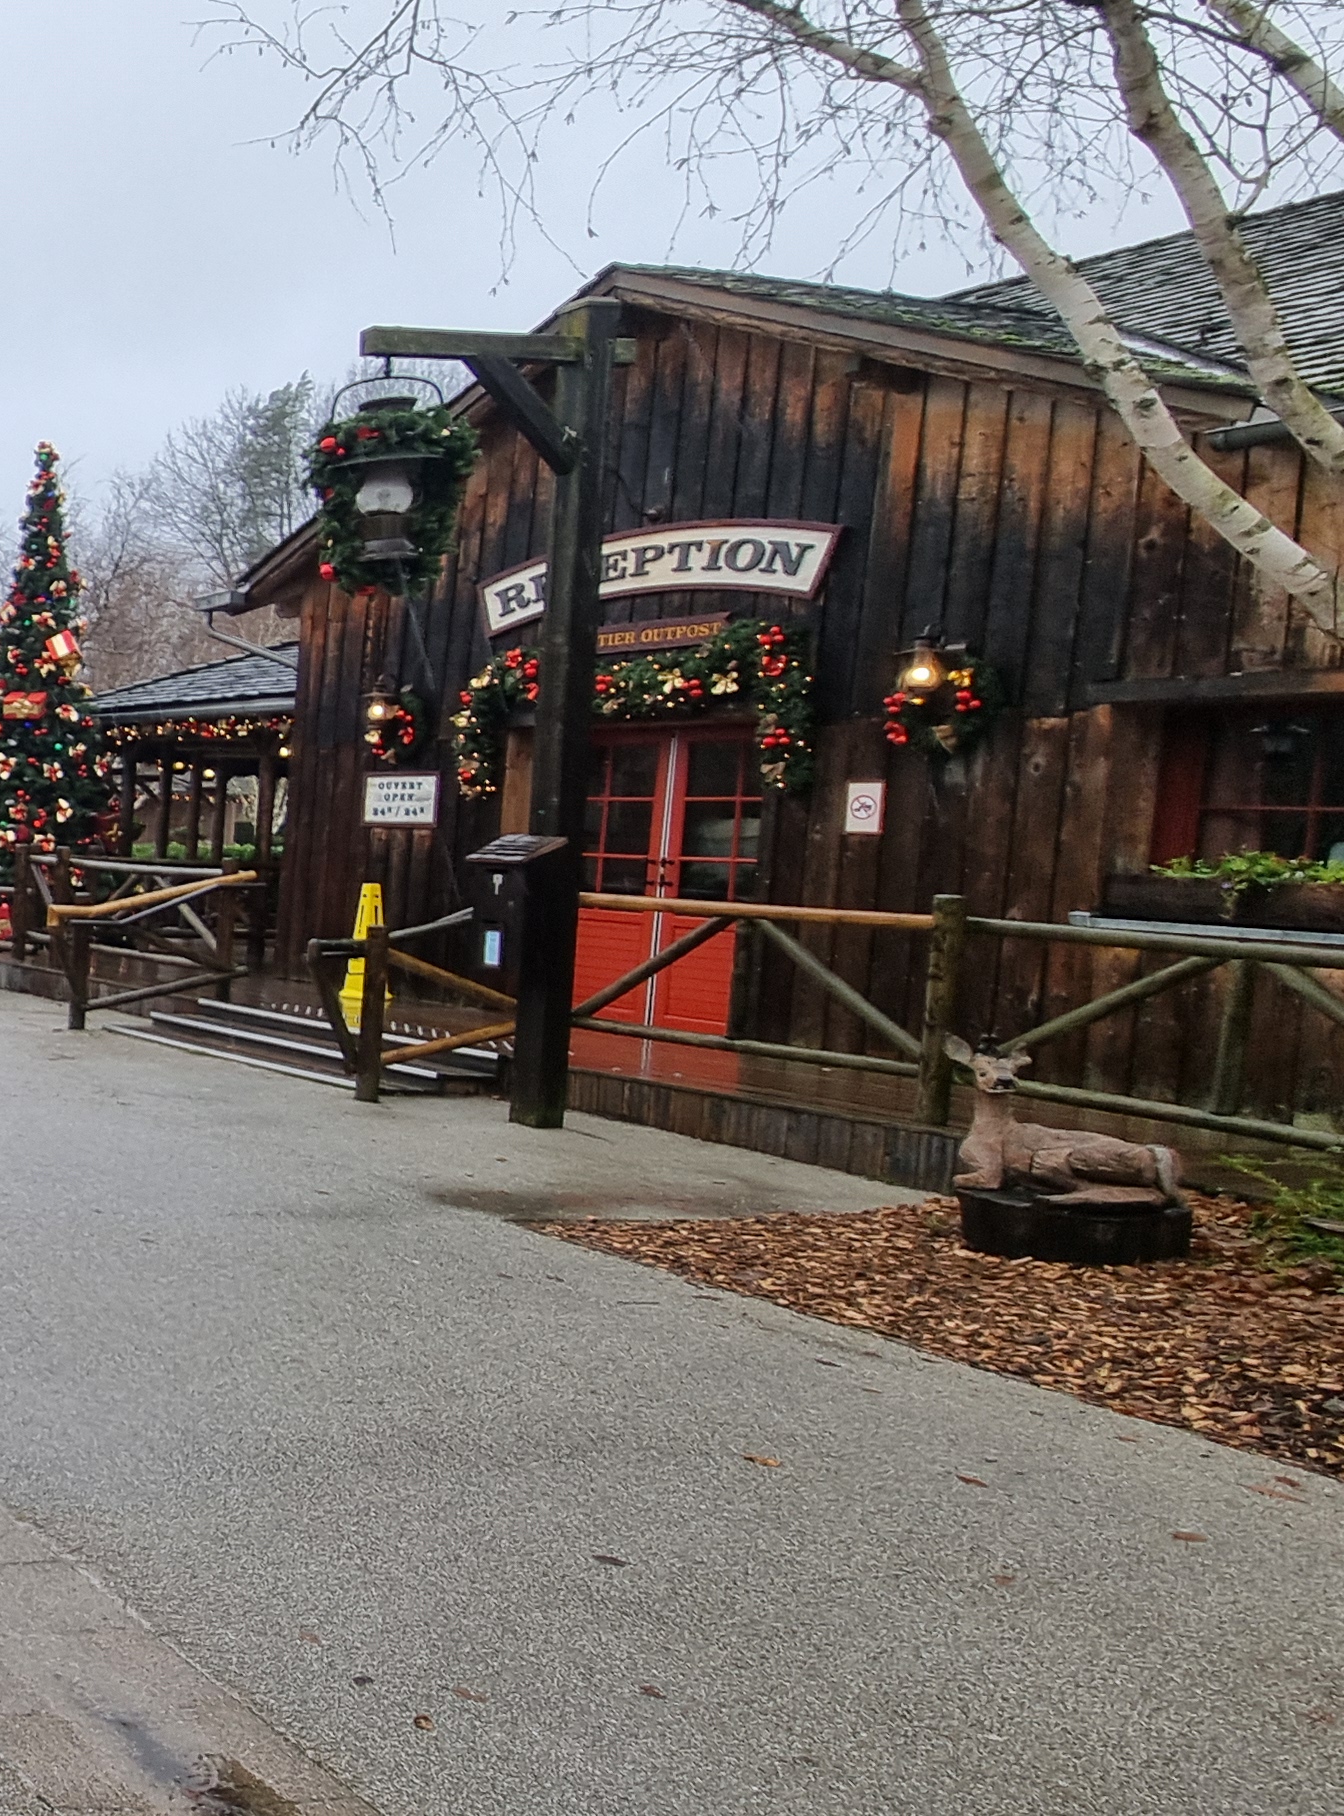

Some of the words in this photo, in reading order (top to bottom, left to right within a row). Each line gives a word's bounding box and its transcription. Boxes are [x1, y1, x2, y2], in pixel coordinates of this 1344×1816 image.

[494, 538, 816, 617] REPTION
[597, 631, 635, 646] TIER
[641, 622, 722, 643] OUTPOST
[378, 781, 422, 790] OUVERT
[384, 793, 414, 801] OPEN
